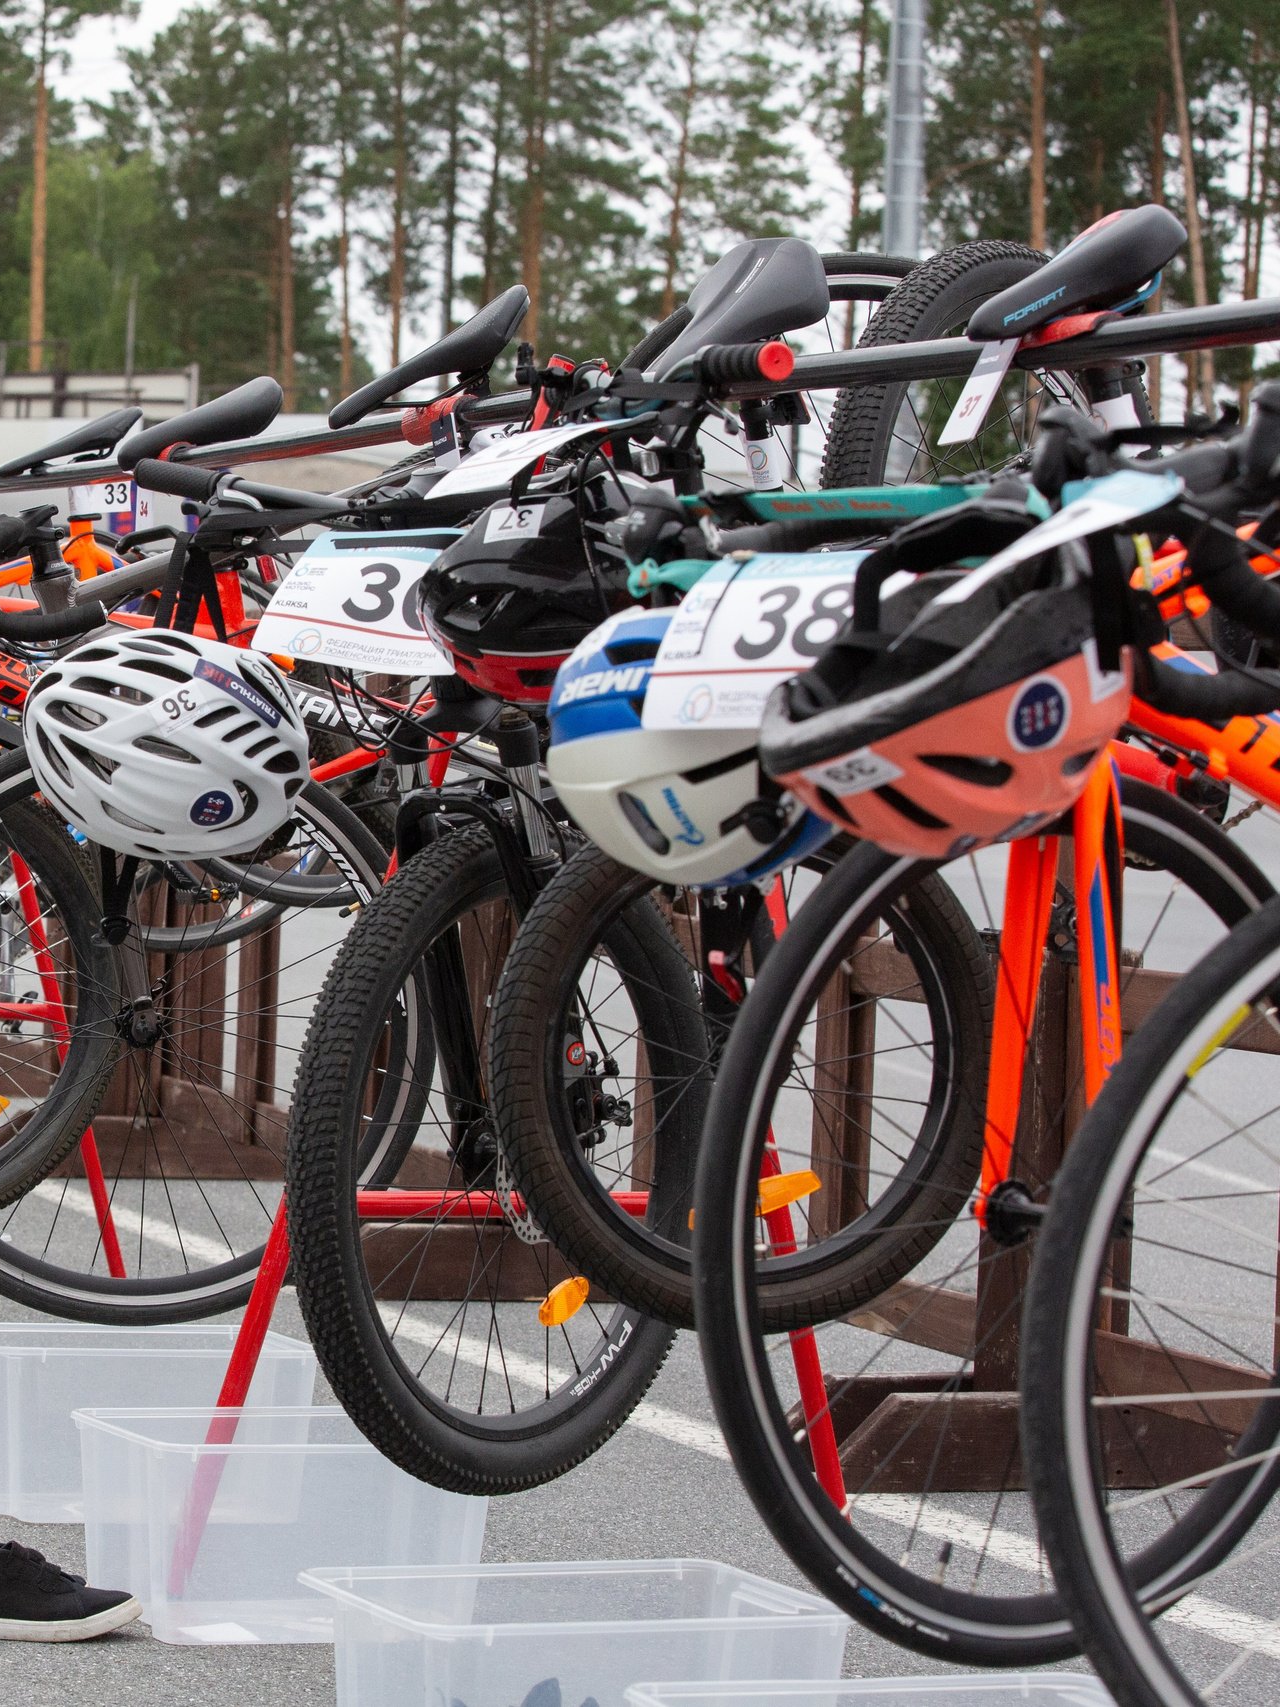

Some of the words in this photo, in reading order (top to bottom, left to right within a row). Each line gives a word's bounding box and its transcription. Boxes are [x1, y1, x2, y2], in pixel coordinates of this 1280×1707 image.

[1003, 285, 1066, 326] FORMAT
[959, 395, 982, 418] 37
[104, 483, 128, 505] 33
[139, 500, 149, 517] 34
[498, 509, 533, 531] 37
[734, 582, 855, 661] 38
[323, 646, 381, 663] ТЮМЕНСКОЙ
[382, 656, 424, 667] ОБЛАСТИ
[326, 638, 385, 654] ФЕДЕРАЦИЯ
[386, 648, 437, 659] ТРИАТЛОНА
[162, 689, 196, 720] 36
